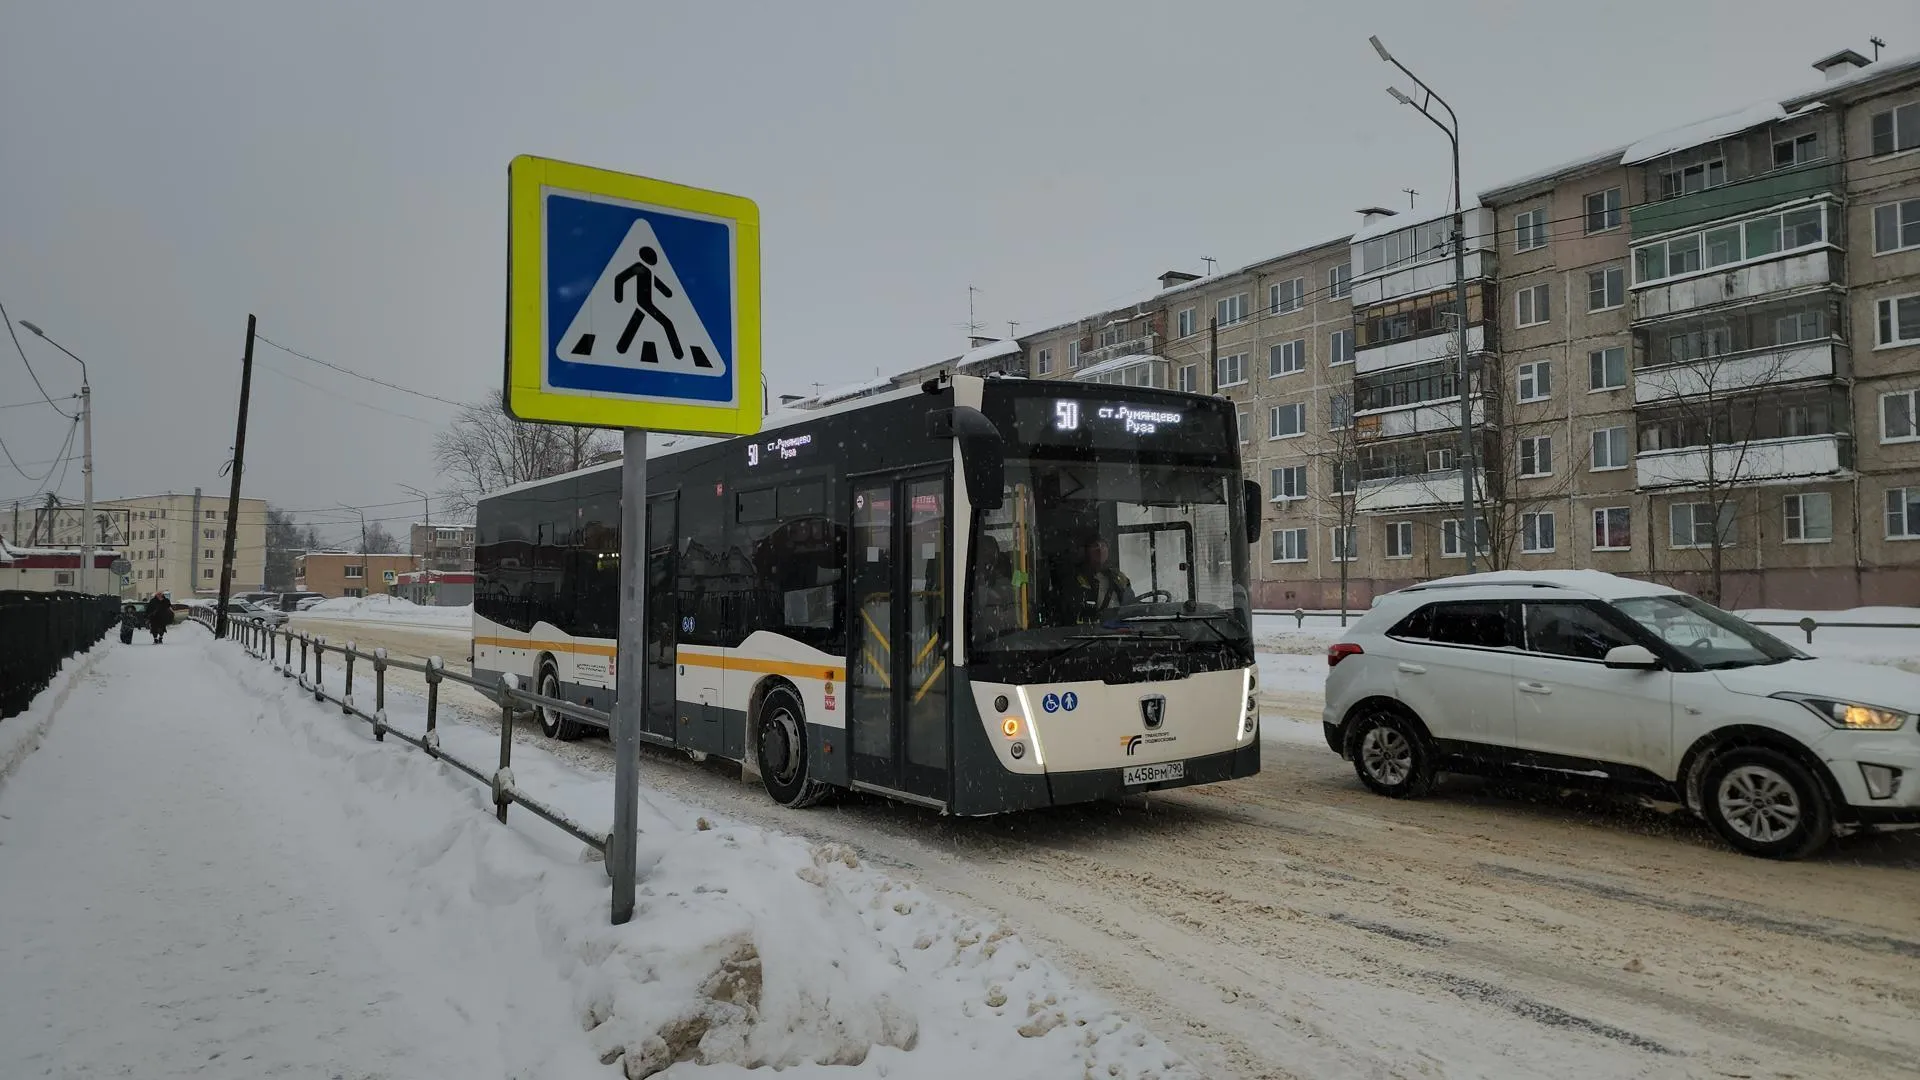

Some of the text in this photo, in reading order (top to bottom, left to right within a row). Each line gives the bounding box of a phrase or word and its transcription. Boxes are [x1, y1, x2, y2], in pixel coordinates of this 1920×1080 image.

[1056, 401, 1078, 430] 50
[1125, 419, 1156, 434] Руза
[747, 443, 759, 467] 50
